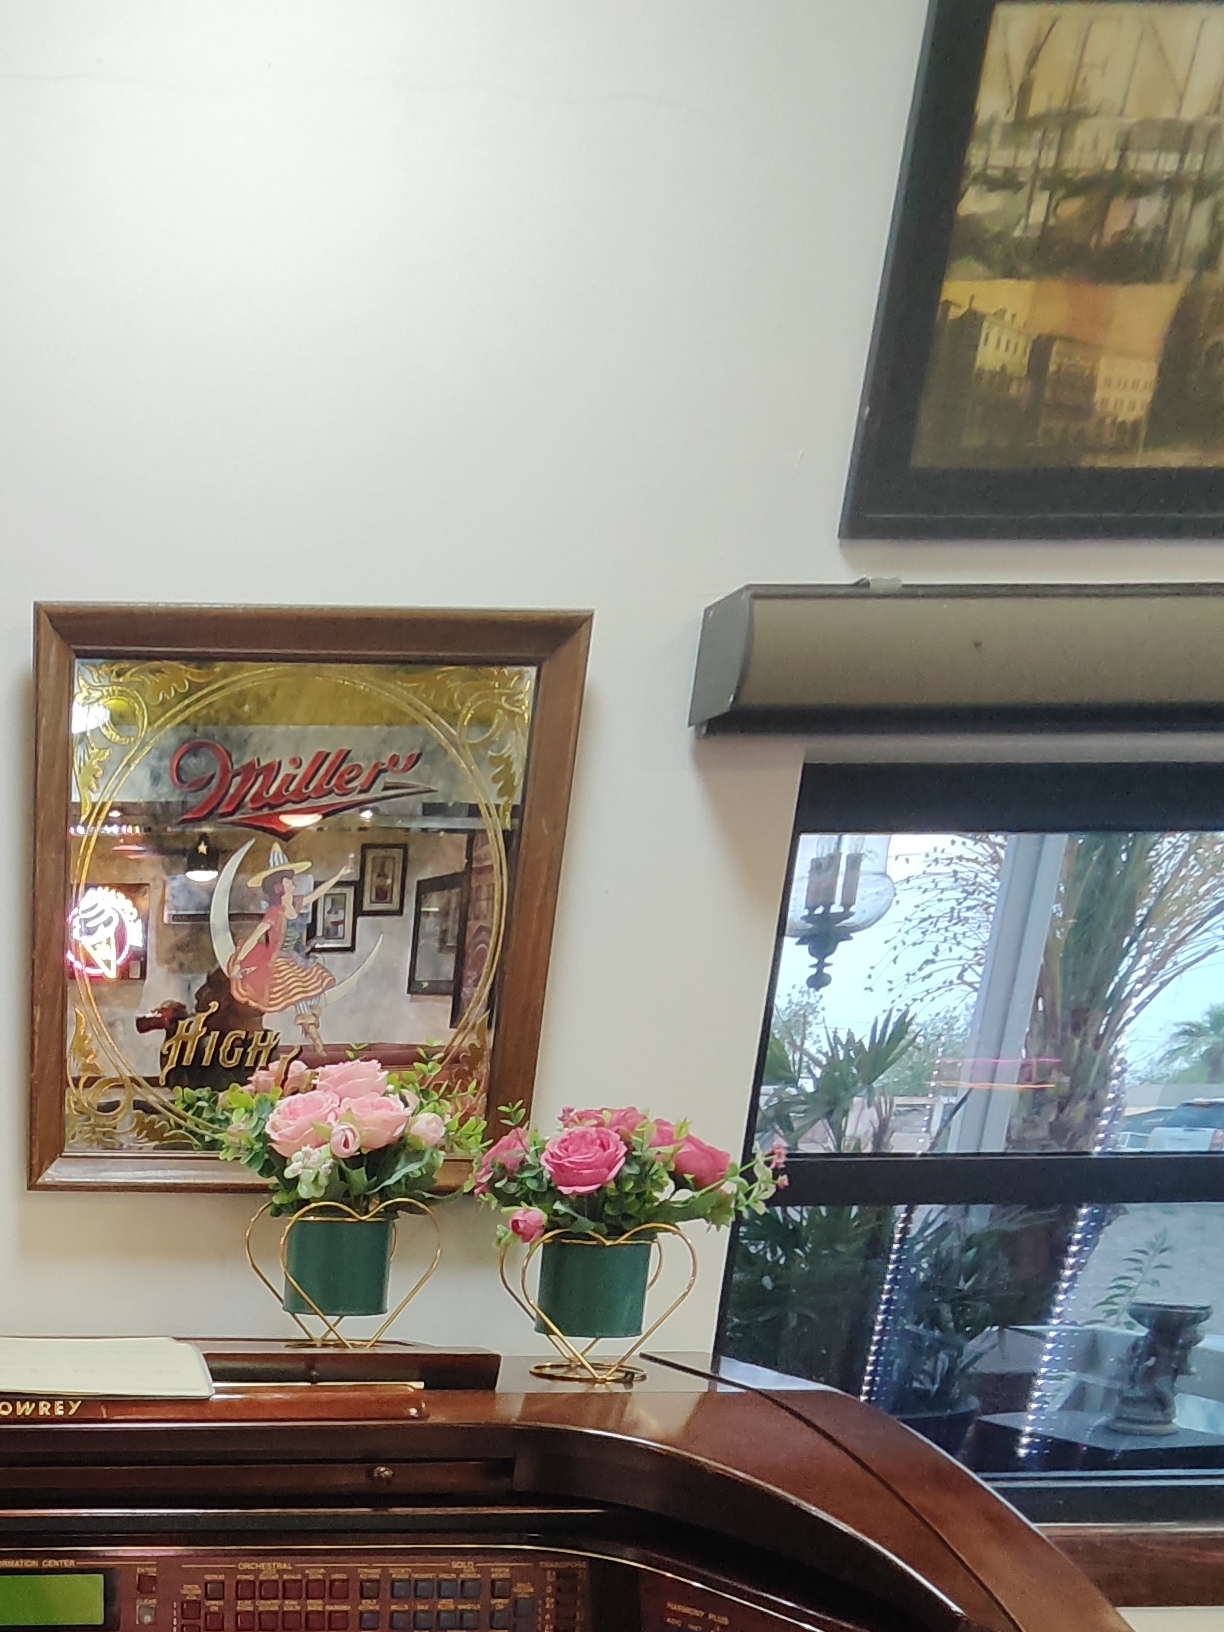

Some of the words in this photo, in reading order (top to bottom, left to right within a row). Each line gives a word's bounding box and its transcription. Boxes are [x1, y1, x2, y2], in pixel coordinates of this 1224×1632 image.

[169, 739, 421, 824] Miller
[159, 1001, 281, 1085] HIGH
[238, 1562, 293, 1570] ORCHESTRAL
